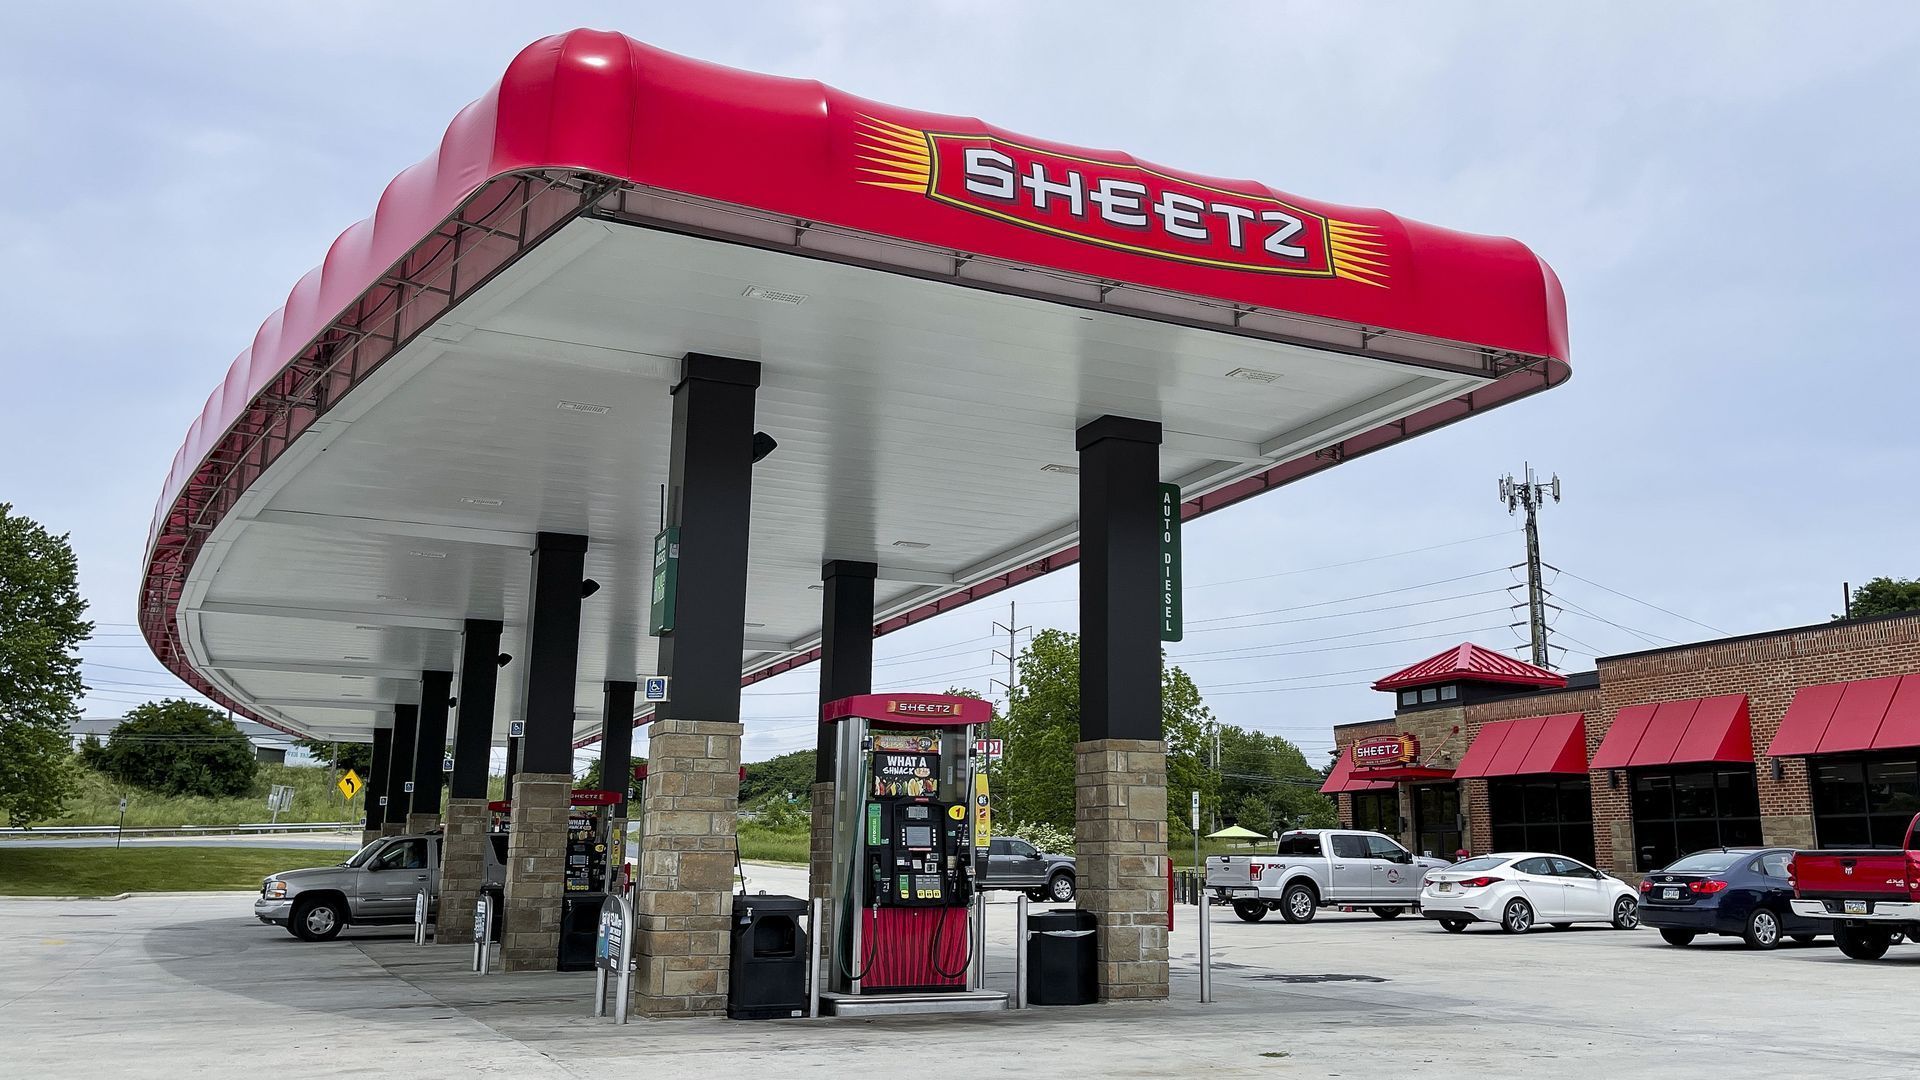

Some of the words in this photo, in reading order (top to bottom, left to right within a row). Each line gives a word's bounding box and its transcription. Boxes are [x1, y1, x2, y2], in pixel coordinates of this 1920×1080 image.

[964, 148, 1307, 259] SHEETZ
[1163, 492, 1171, 543] AUTO
[1164, 553, 1172, 632] DIESEL
[899, 703, 950, 713] SHEETZ
[1357, 744, 1399, 757] SHEETZ
[887, 756, 917, 767] WHAT
[919, 757, 927, 767] A
[955, 807, 961, 818] 1
